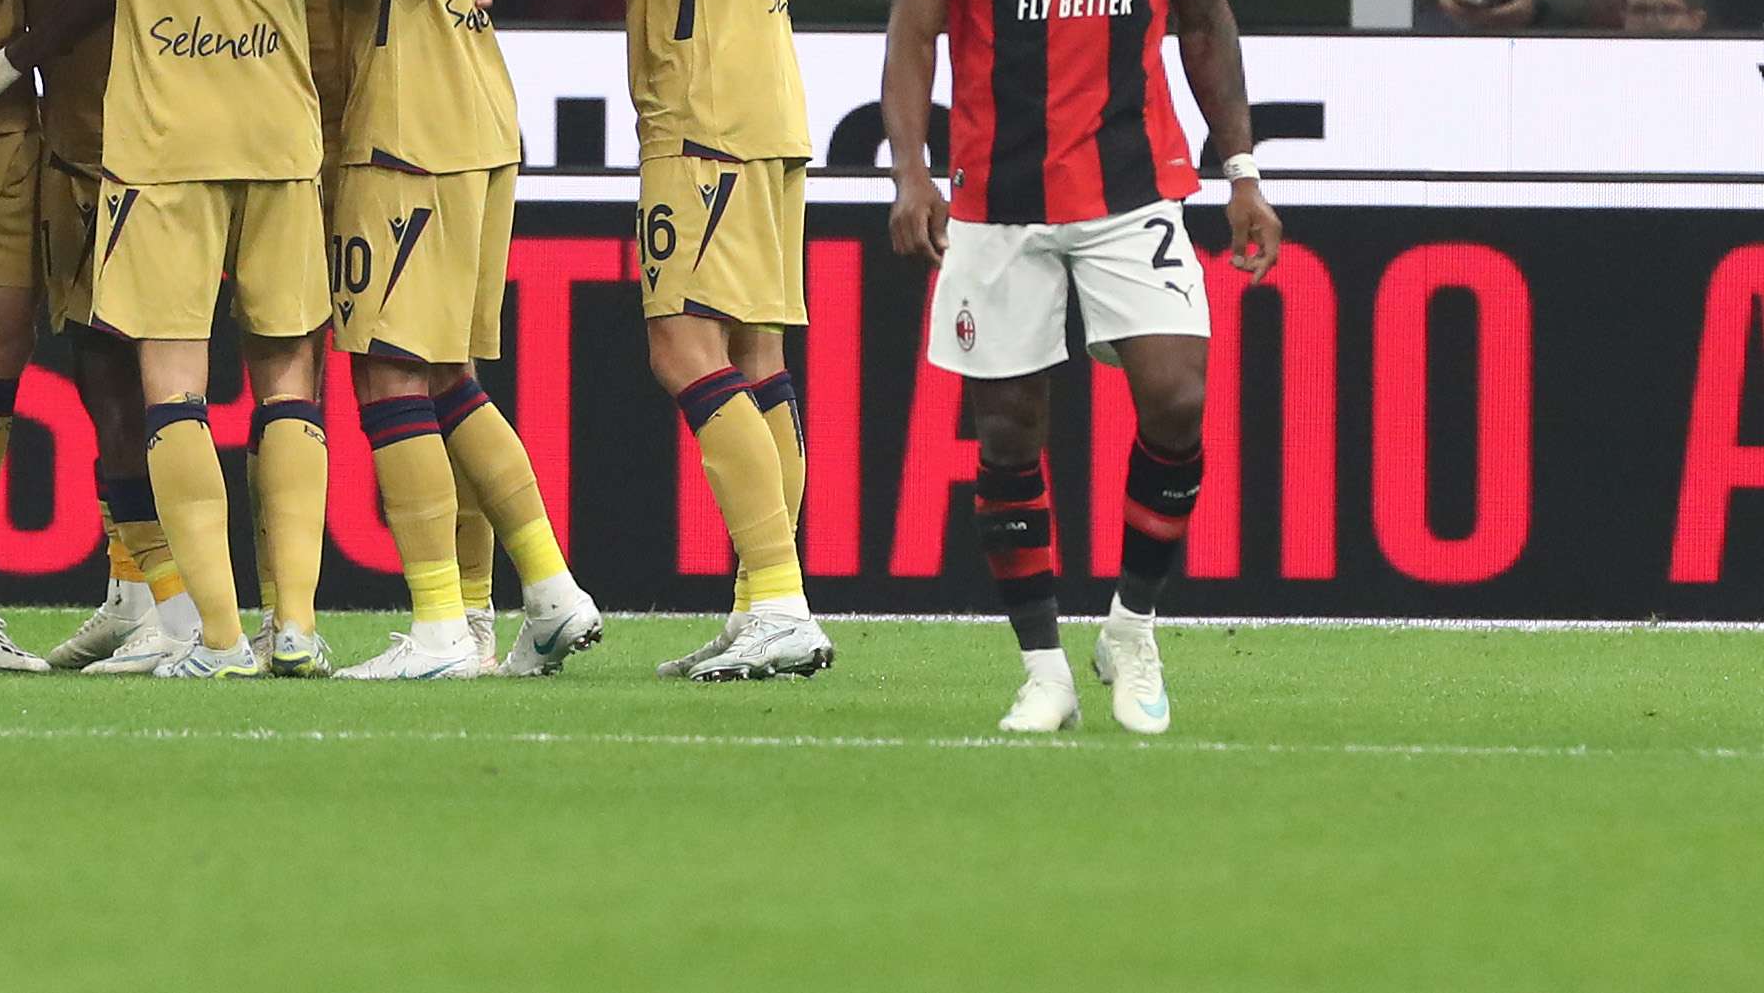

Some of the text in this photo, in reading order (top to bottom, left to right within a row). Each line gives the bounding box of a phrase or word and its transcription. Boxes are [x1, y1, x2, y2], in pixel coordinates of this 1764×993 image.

[149, 15, 280, 60] Selenella
[638, 203, 677, 265] 16
[1144, 217, 1183, 269] 2
[331, 234, 372, 294] 10
